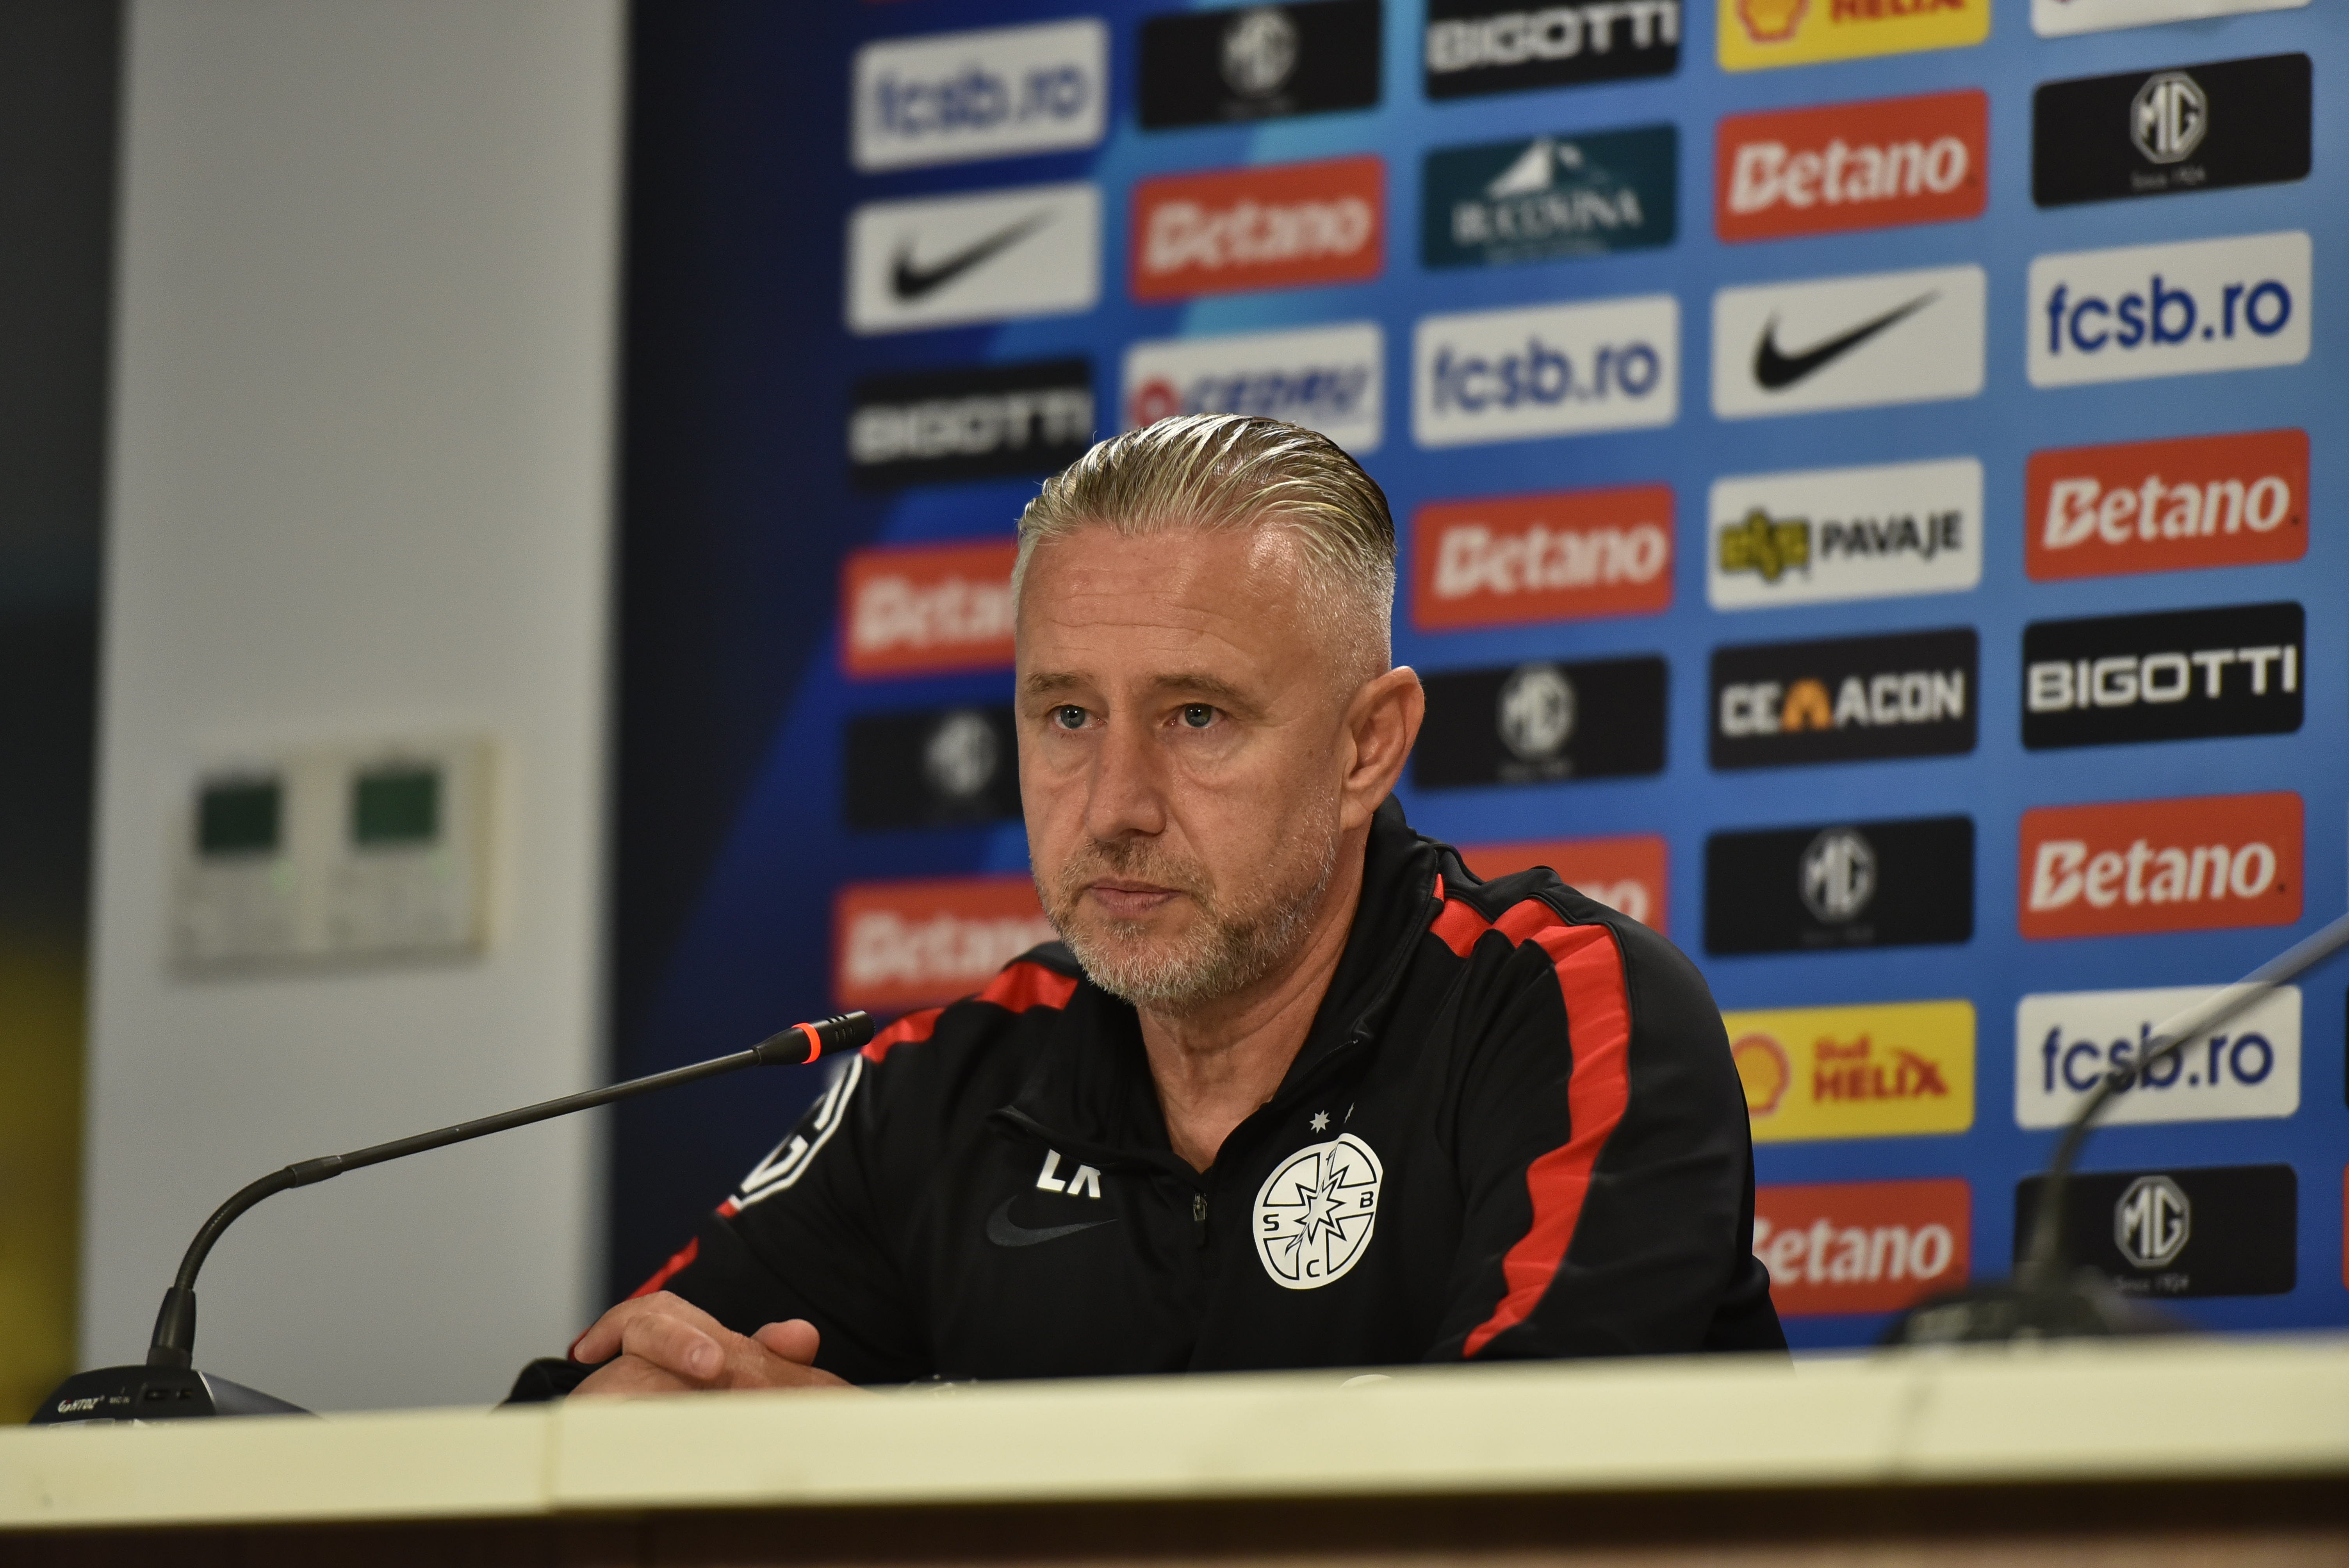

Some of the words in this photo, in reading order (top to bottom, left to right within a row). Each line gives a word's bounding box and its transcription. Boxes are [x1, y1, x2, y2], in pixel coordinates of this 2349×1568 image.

[1426, 0, 1680, 73] BIGOTTI
[1730, 137, 1969, 214] Betano
[1142, 198, 1371, 276] Betano
[2047, 272, 2292, 356] fcsb.ro
[1433, 335, 1660, 416] fcsb.ro
[1820, 510, 1962, 561] PAVAJE
[2042, 474, 2290, 551] Betano
[1433, 522, 1668, 599] Betano
[854, 576, 1015, 653] Beta
[2028, 644, 2297, 712] BIGOTTI
[2028, 839, 2276, 912] Betano
[2042, 1021, 2274, 1094] fcsb.ro
[2123, 1182, 2183, 1260] MG
